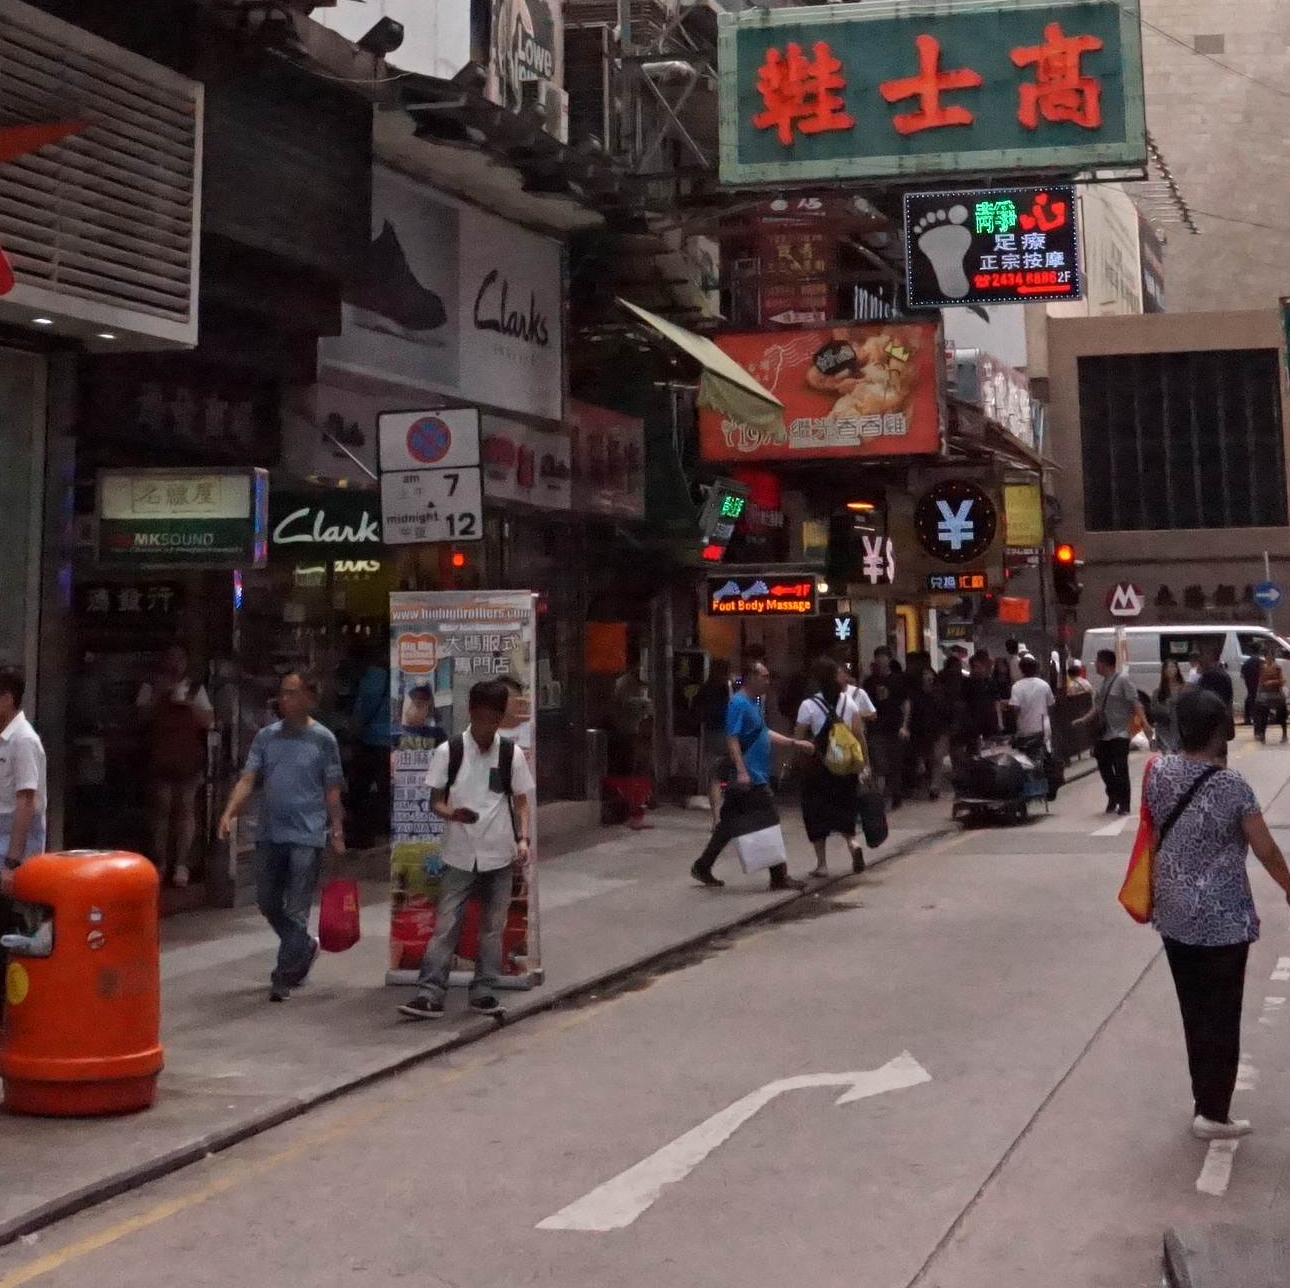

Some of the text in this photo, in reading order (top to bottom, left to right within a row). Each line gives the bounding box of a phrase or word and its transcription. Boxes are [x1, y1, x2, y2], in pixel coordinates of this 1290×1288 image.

[993, 232, 1046, 252] 足療
[980, 251, 1066, 271] 正宗按摩
[1057, 271, 1071, 283] 2F
[474, 269, 549, 348] Clarks
[402, 474, 459, 497] am 7
[273, 508, 380, 544] Clark
[386, 512, 476, 536] midnight 12
[713, 599, 811, 613] Foot Body Massage
[444, 633, 520, 653] 大碼服式
